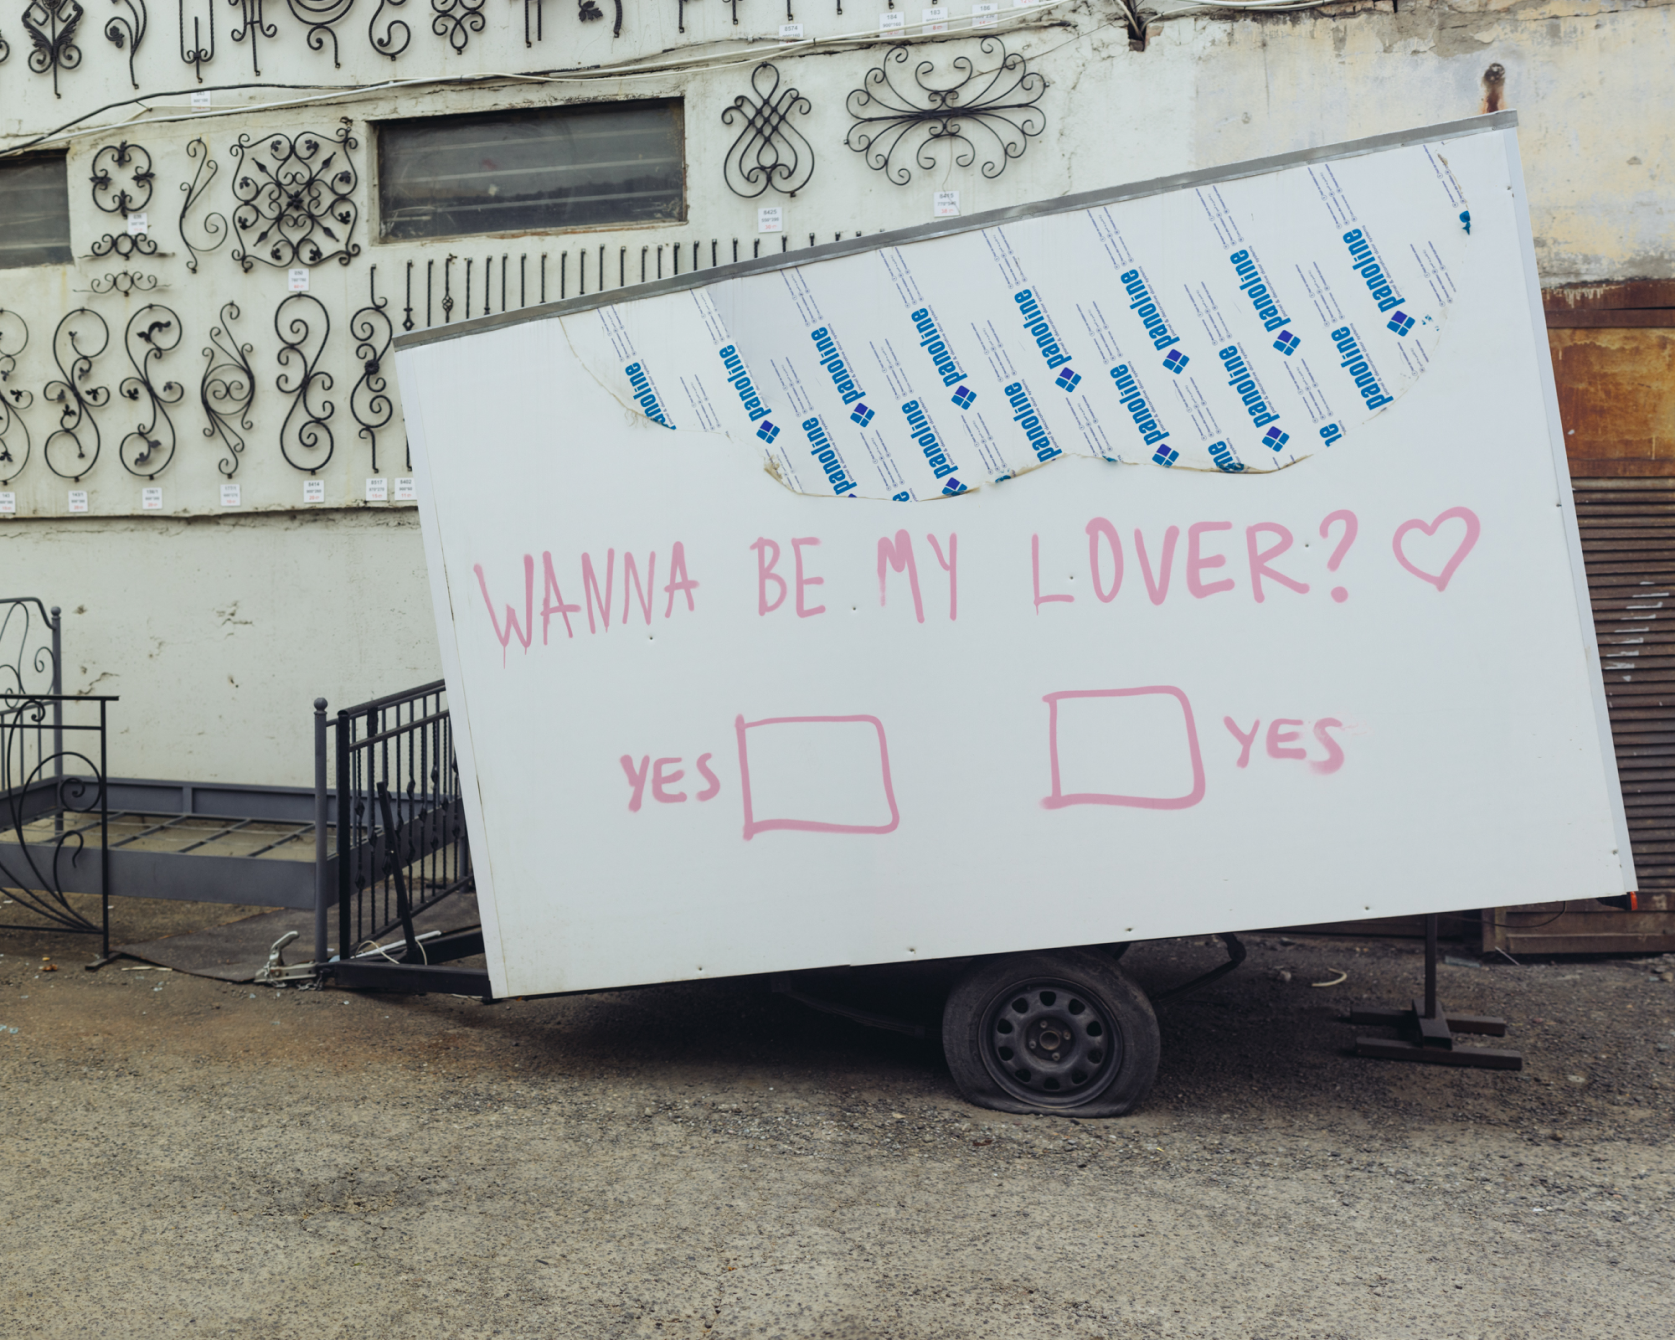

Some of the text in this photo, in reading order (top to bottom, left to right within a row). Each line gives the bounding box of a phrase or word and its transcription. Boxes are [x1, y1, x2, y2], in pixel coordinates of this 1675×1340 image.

[1120, 269, 1180, 351] panoline
[1230, 249, 1291, 332] panoline
[1343, 228, 1405, 312] panoline
[811, 326, 866, 405] panoline
[911, 308, 967, 387] panoline
[1014, 289, 1072, 369] panoline
[1331, 326, 1393, 410] panoline
[719, 344, 772, 422] panoline
[1004, 382, 1062, 462] panoline
[1110, 364, 1169, 445] panoline
[1219, 345, 1280, 428] panoline
[802, 417, 857, 495] panoline
[901, 400, 958, 479] panoline
[474, 509, 1359, 668] WANNA BE MY LOVER?
[620, 753, 721, 812] YES
[1223, 716, 1345, 775] YES
